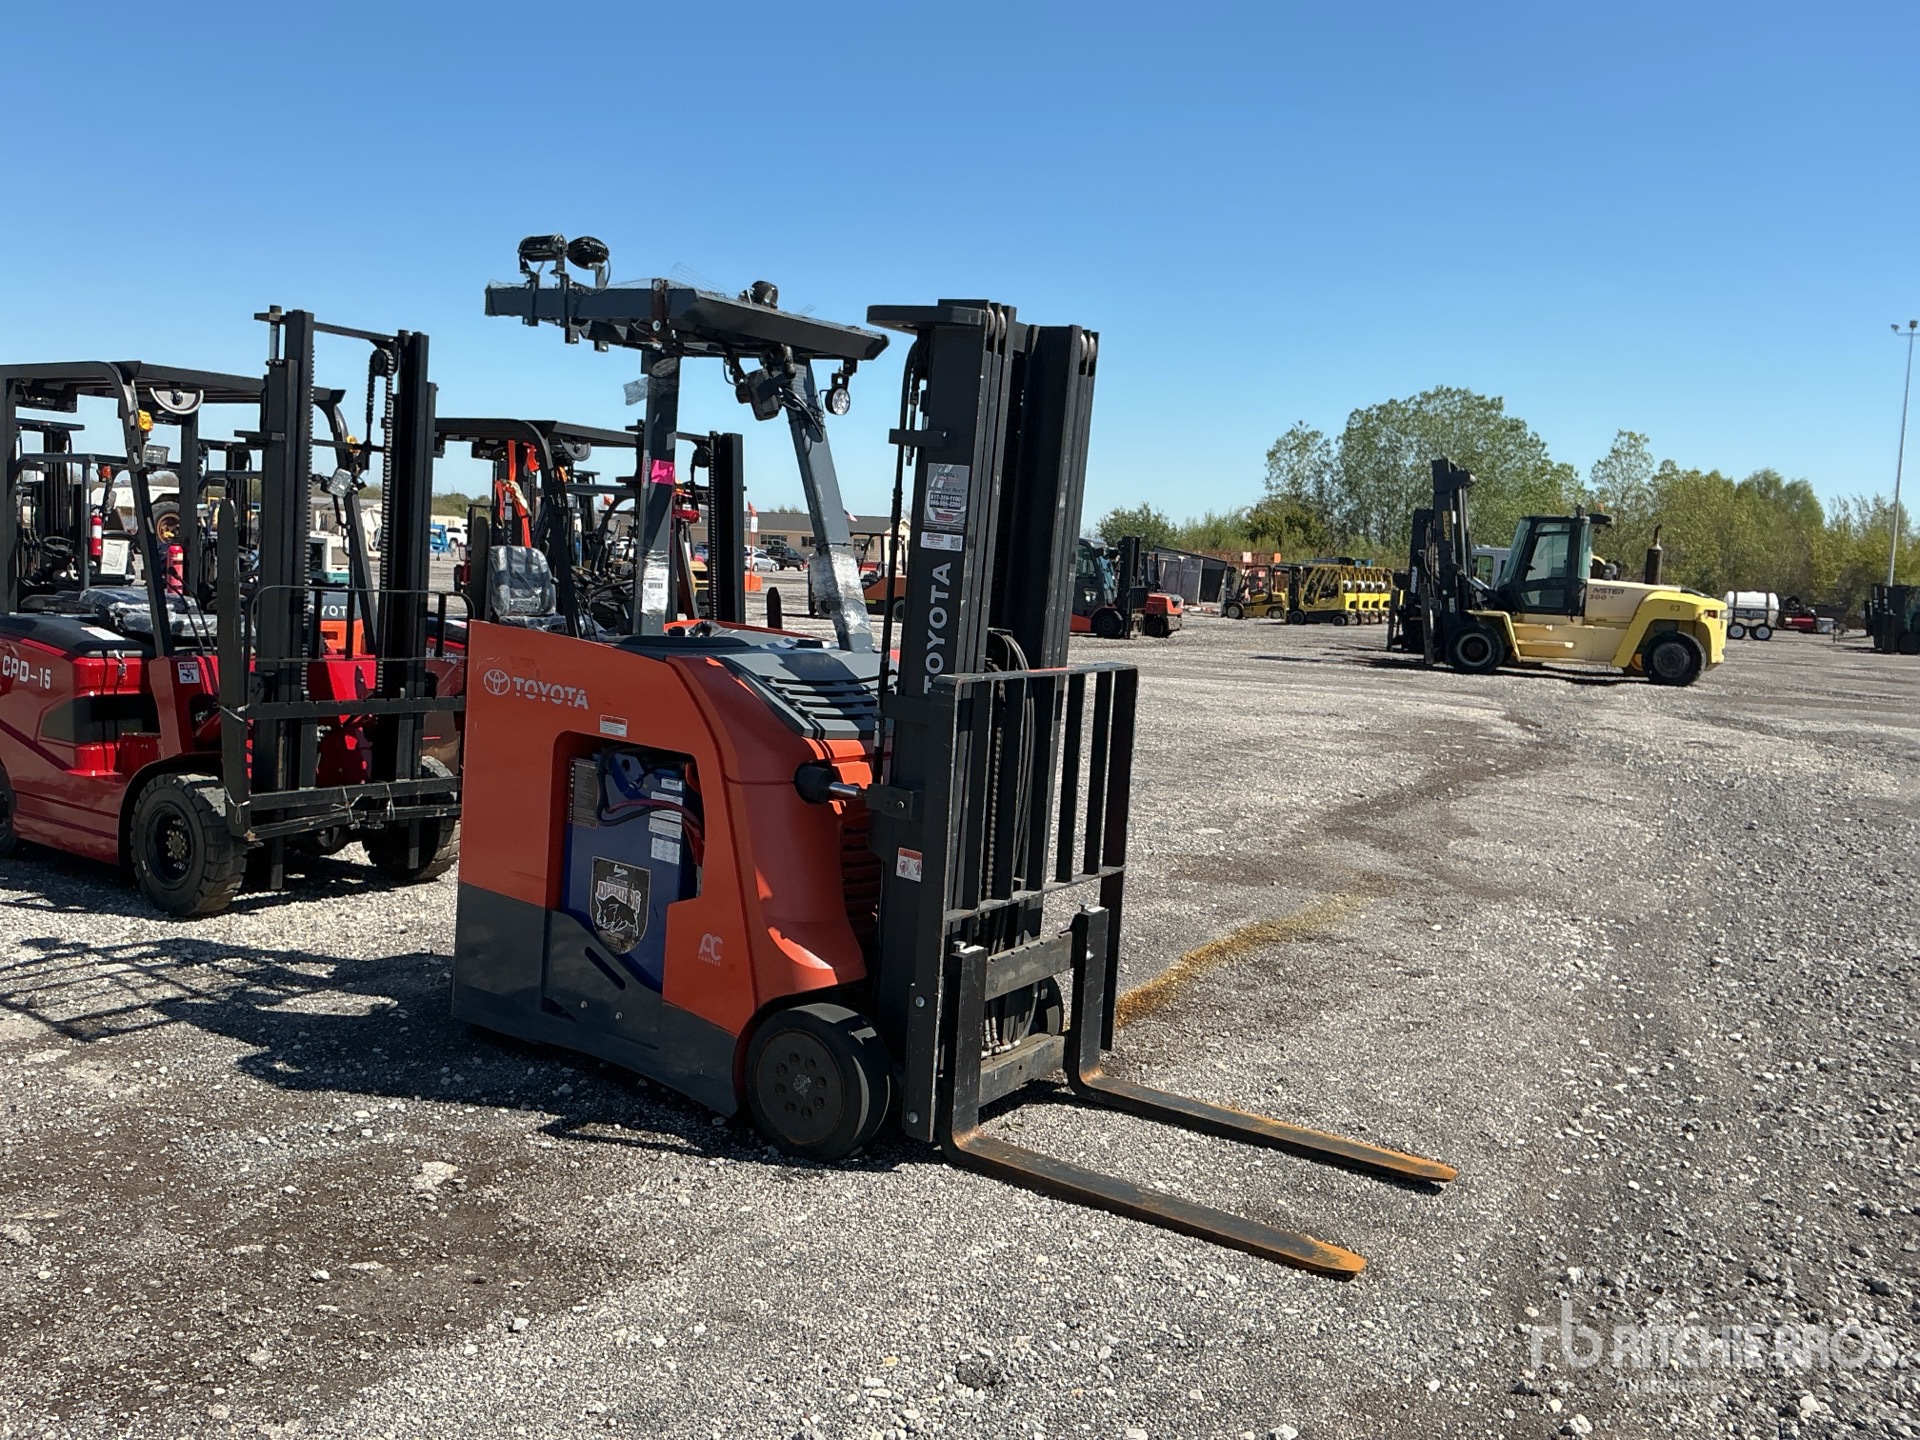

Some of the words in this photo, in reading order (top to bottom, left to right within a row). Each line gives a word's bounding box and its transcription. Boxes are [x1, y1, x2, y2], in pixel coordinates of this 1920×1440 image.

[923, 562, 952, 695] TOYOTA
[2, 655, 51, 690] CPD-15
[512, 676, 589, 710] TOYOTA
